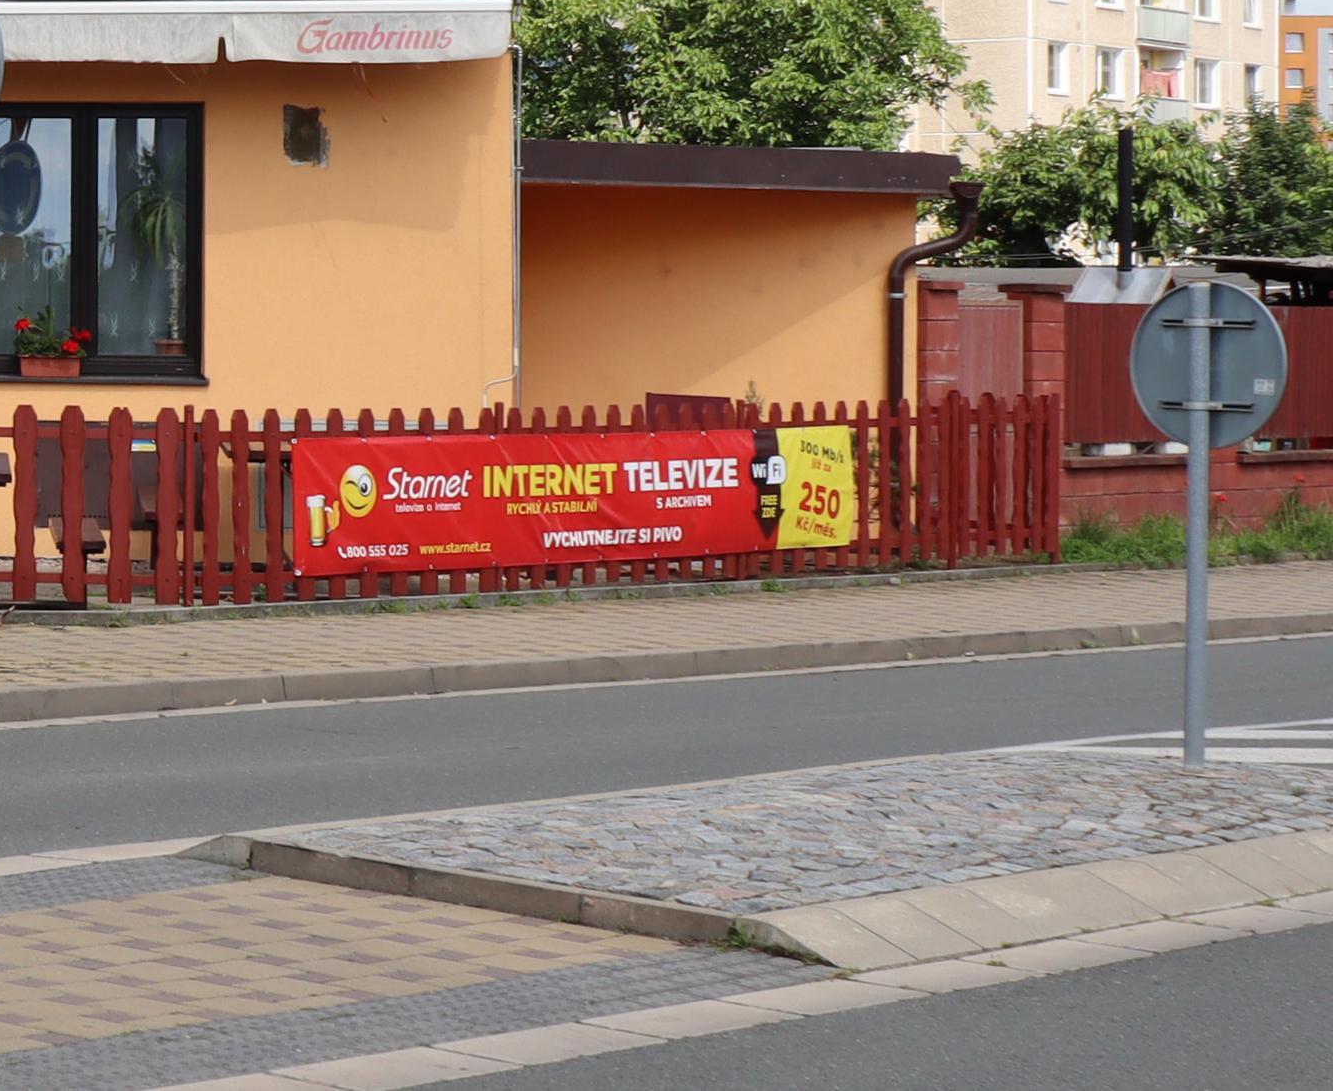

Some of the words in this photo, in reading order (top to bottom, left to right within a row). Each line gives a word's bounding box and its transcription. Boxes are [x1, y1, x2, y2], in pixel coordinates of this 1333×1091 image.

[296, 18, 454, 55] Gambrinus
[800, 440, 819, 456] 300
[821, 446, 844, 463] Mb/s
[382, 467, 473, 500] Starnet
[483, 463, 618, 498] INTERNET
[623, 458, 740, 492] TELEVIZE
[506, 500, 542, 516] RYCHLÝ
[544, 503, 550, 514] A
[552, 498, 598, 514] STABILNÍ
[656, 497, 663, 509] S
[665, 495, 712, 509] ARCHIVEM
[760, 494, 778, 506] FREE
[799, 481, 840, 519] 250
[761, 507, 776, 518] ZDE
[543, 528, 636, 548] VYCHUTNEJTE
[638, 527, 651, 543] SI
[653, 525, 682, 543] PIVO
[796, 515, 837, 539] Kč/měs.
[347, 545, 366, 558] 800
[368, 544, 387, 557] 555
[389, 544, 409, 556] 025
[419, 542, 492, 555] www.starnet.cz
